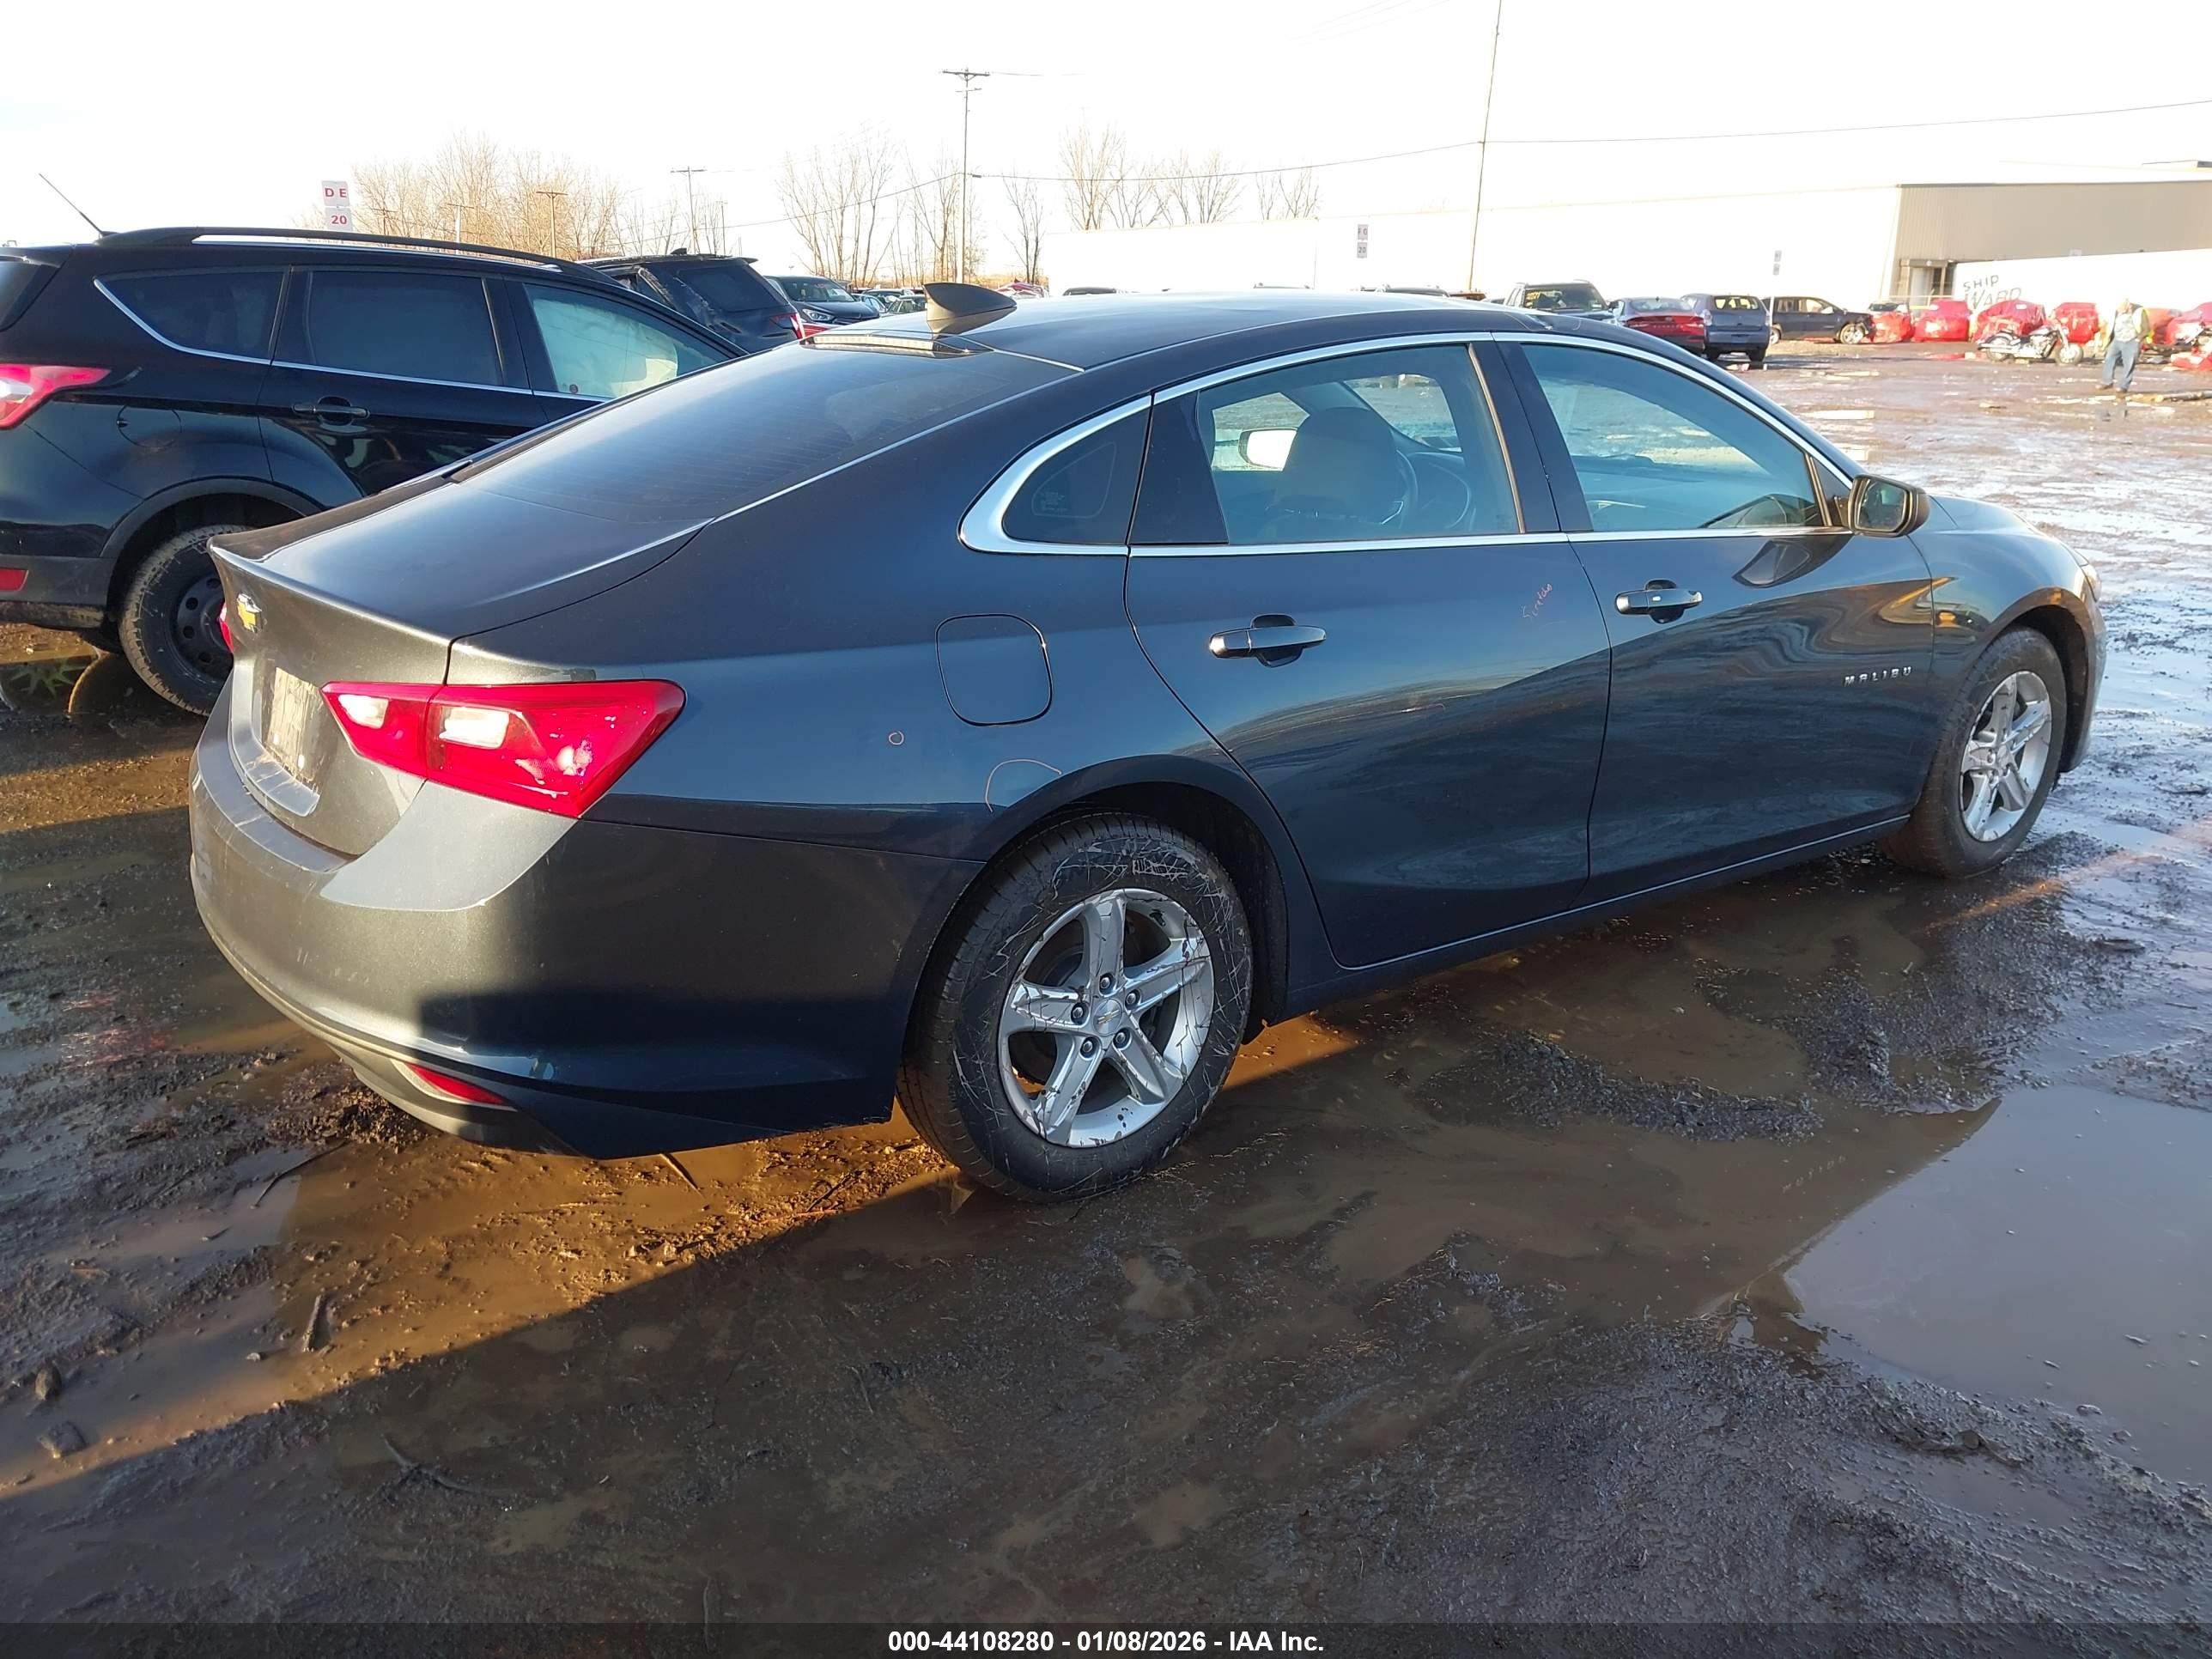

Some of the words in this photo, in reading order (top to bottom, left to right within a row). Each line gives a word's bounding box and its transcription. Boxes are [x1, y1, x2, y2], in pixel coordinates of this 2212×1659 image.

[325, 187, 335, 198] D
[338, 188, 348, 198] E
[331, 215, 348, 225] 20
[1963, 274, 2000, 293] SHIP
[1843, 665, 1913, 688] MALIBU
